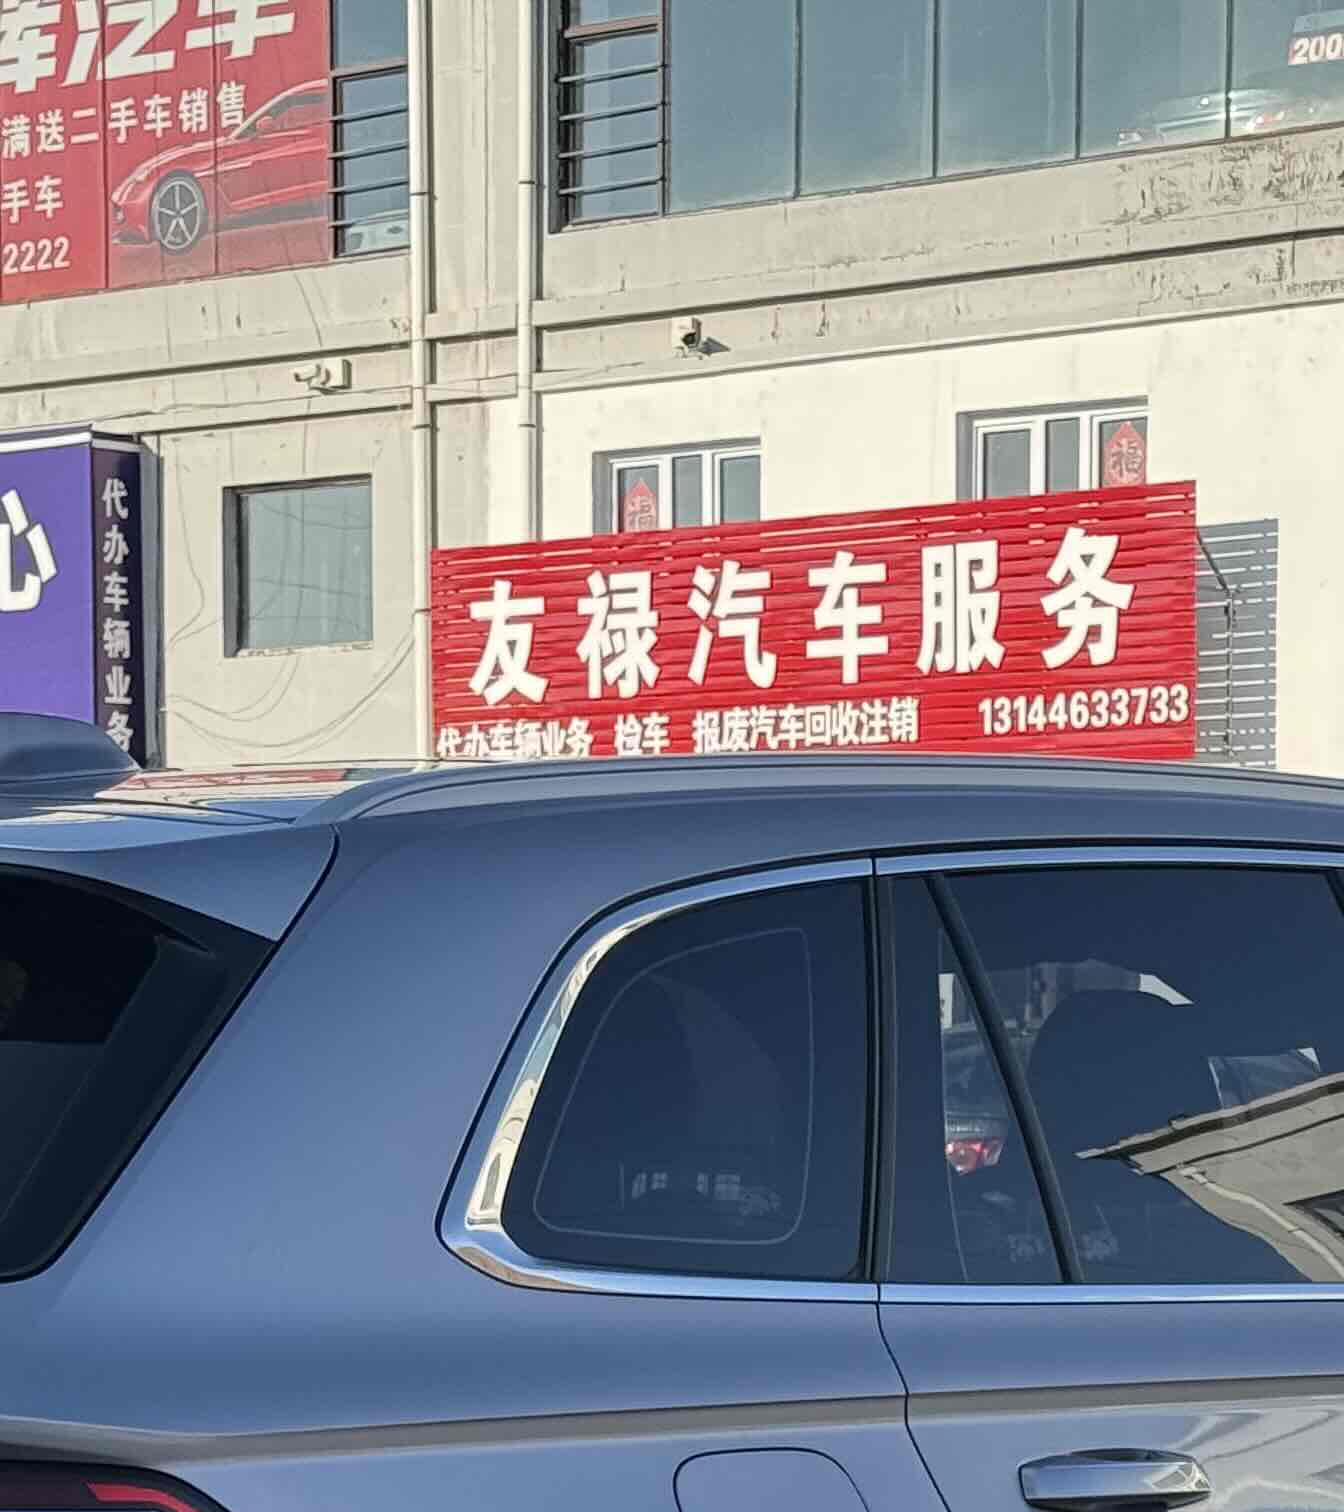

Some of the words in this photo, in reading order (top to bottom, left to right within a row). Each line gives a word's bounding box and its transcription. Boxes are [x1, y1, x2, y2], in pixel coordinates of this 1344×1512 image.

[101, 476, 135, 752] 代办车辆业务
[468, 526, 1135, 706] 友禄汽车服务
[436, 717, 594, 759] 代办车辆业务
[614, 712, 670, 755] 检车
[692, 696, 921, 754] 报废汽车回收注销
[978, 683, 1190, 735] 13144633733
